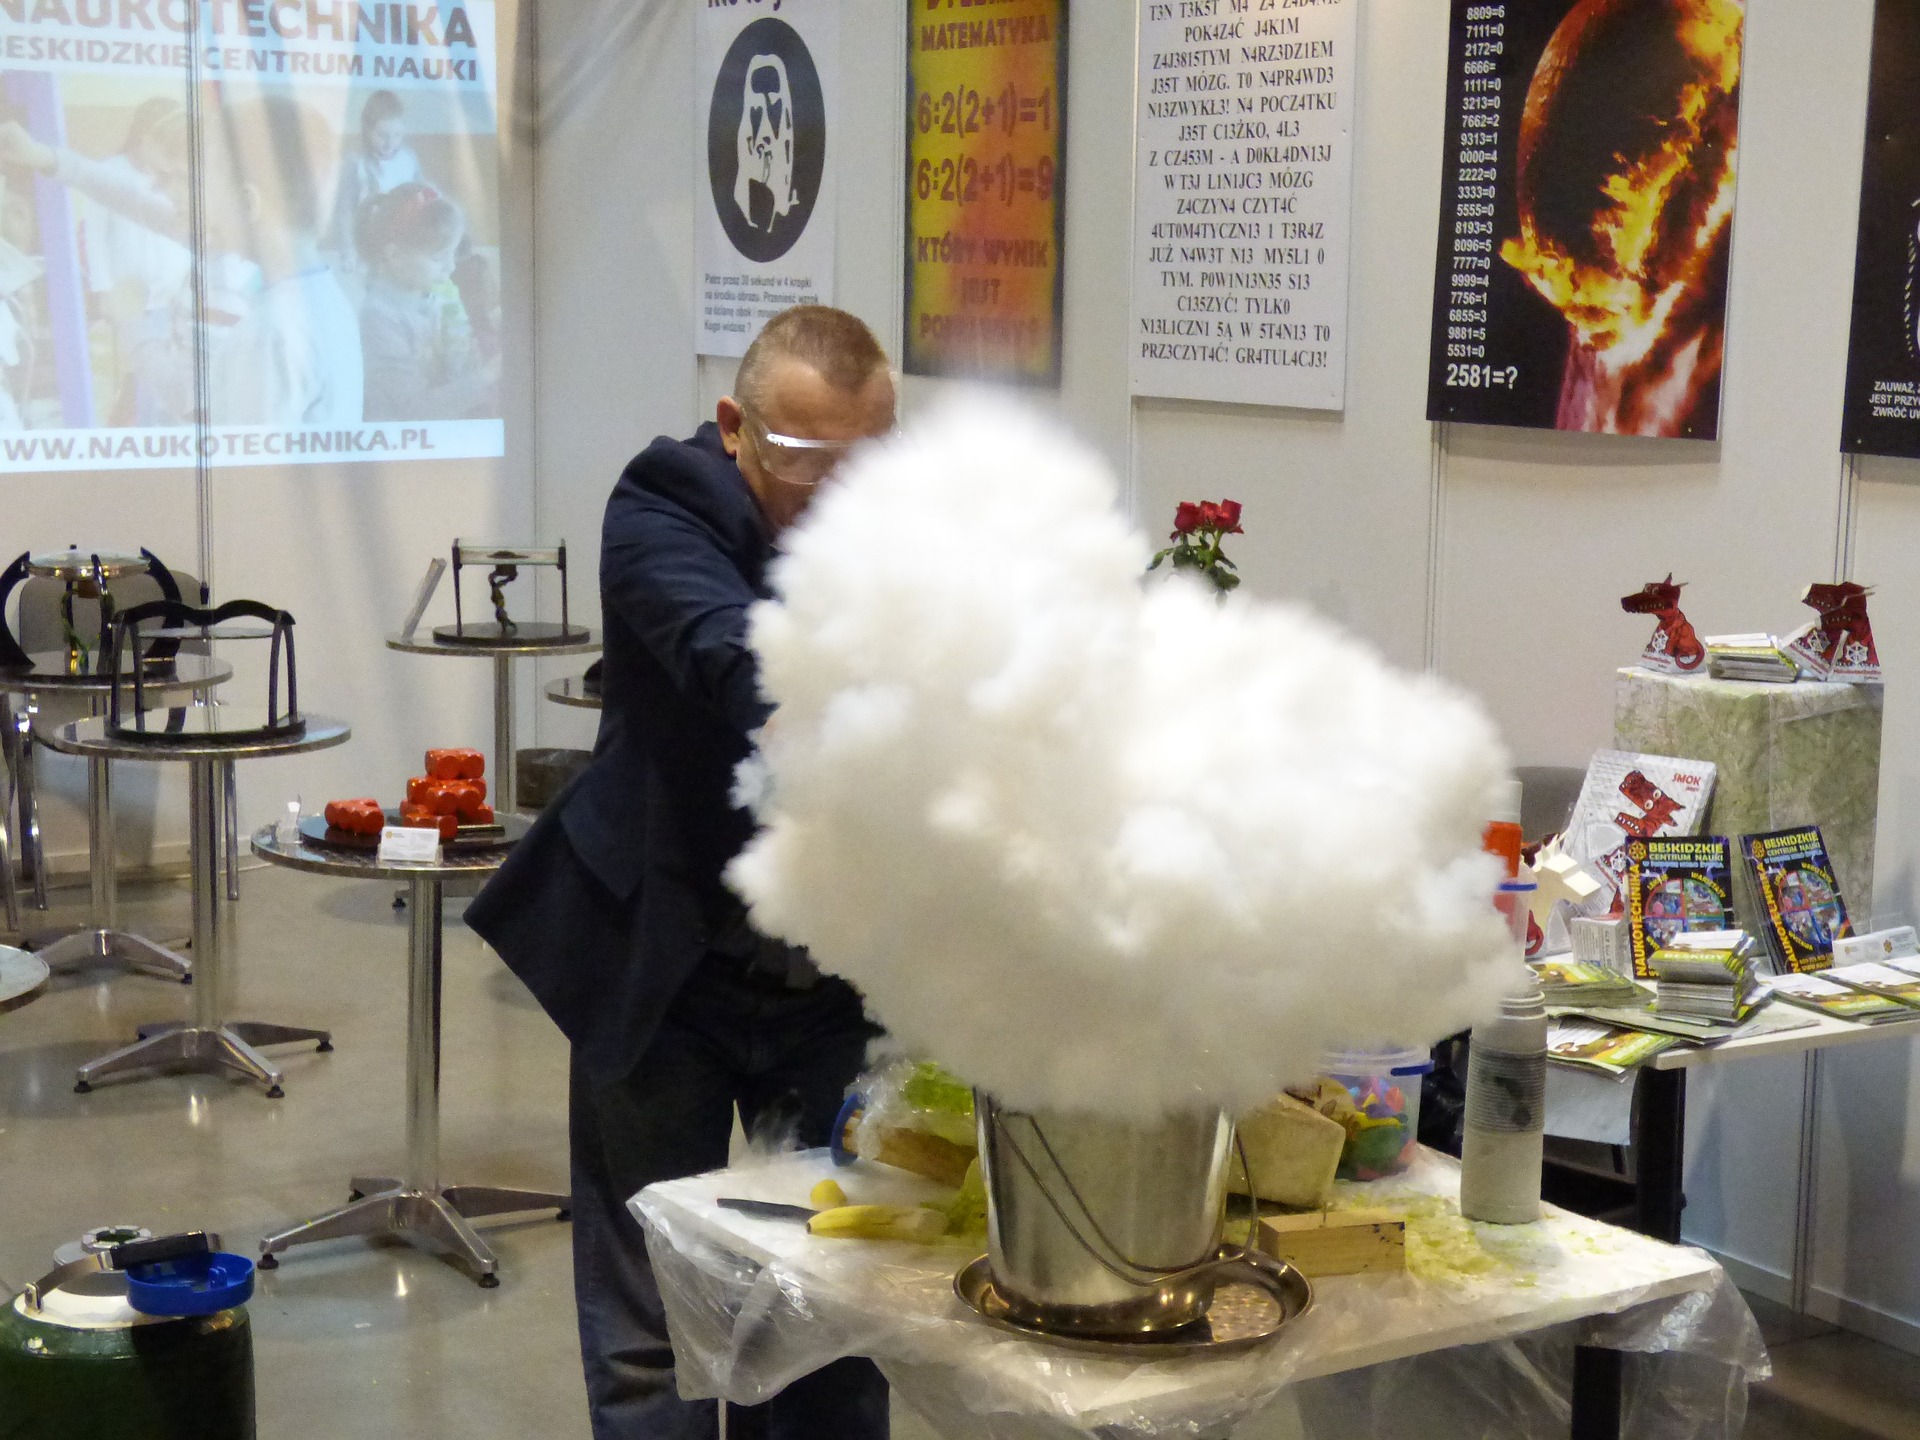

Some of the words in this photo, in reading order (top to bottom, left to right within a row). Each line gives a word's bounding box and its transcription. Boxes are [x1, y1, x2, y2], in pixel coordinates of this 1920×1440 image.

[1149, 3, 1173, 21] T3N
[1180, 0, 1219, 19] T3K5T
[1466, 5, 1505, 20] 8809=6
[921, 15, 1050, 51] MATEMATYKA
[1254, 17, 1300, 38] J4K1M
[1466, 23, 1504, 39] 7111=0
[1241, 40, 1334, 64] N4RZ3DZ1EM
[1464, 41, 1504, 57] 2172=0
[0, 35, 192, 69] ESKIDZKIE
[203, 47, 363, 77] CENTRUM
[374, 56, 477, 81] NAUKI
[1464, 60, 1496, 74] 6666=
[1151, 76, 1180, 95] J35T
[1185, 70, 1230, 92] MÓZG.
[1259, 66, 1334, 87] N4PR4WD3
[1464, 78, 1502, 92] 1111=0
[918, 82, 1050, 138] 6:2(2+1)=1
[1237, 98, 1253, 114] N4
[1462, 95, 1501, 111] 3213=0
[1462, 114, 1500, 128] 7662=2
[1178, 124, 1207, 142] J35T
[1276, 120, 1300, 138] 4L3
[1460, 132, 1498, 146] 9313=1
[1149, 150, 1158, 166] Z
[1164, 148, 1213, 166] CZ453M
[1230, 150, 1240, 164] A
[1460, 150, 1498, 163] 0000=4
[917, 153, 1054, 207] 6:2(2+1)=9
[1164, 175, 1176, 190] W
[1181, 174, 1201, 190] T3J
[1208, 172, 1262, 190] L1N1JC3
[1269, 166, 1314, 189] MÓZG
[1458, 168, 1497, 181] 2222=0
[1457, 185, 1496, 199] 3333=0
[1177, 198, 1235, 214] Z4CZYN4
[1242, 192, 1298, 214] CZYT4Ć
[1456, 203, 1495, 217] 5555=0
[1281, 222, 1325, 239] T3R4Z
[1455, 221, 1493, 235] 8193=3
[1454, 239, 1492, 252] 8096=5
[1149, 243, 1174, 263] JUŻ
[1180, 247, 1224, 264] N4W3T
[1230, 247, 1254, 264] N13
[1264, 248, 1309, 265] MY5L1
[1453, 256, 1491, 270] 7777=0
[1161, 271, 1193, 287] TYM.
[1451, 274, 1490, 287] 9999=4
[1177, 292, 1238, 313] C135ZYĆ!
[1450, 291, 1488, 305] 7756=1
[1449, 308, 1487, 323] 6855=3
[1140, 318, 1209, 337] N13L1CZN1
[1240, 322, 1252, 338] W
[1259, 323, 1306, 341] 5T4N13
[1448, 326, 1486, 340] 9881=5
[1141, 342, 1229, 363] PRZ3CZYT4Ć!
[1235, 347, 1327, 368] GR4TUL4CJ3!
[1447, 344, 1485, 358] 5531=0
[1446, 363, 1518, 390] 2581=?
[1874, 381, 1915, 394] ZAUWAŻ,
[1869, 394, 1892, 404] JEST
[1872, 406, 1907, 418] ZWRÓĆ
[1672, 773, 1701, 786] SMOK
[1648, 842, 1724, 854] BESKIDZKIE
[1763, 831, 1819, 849] BESKIDZKIE
[1649, 853, 1692, 861] CENTRUM
[1695, 853, 1724, 861] NAUKI
[1629, 864, 1648, 977] NAUKOTECHNIKA
[1757, 862, 1801, 973] NAUKOTECHNIKA
